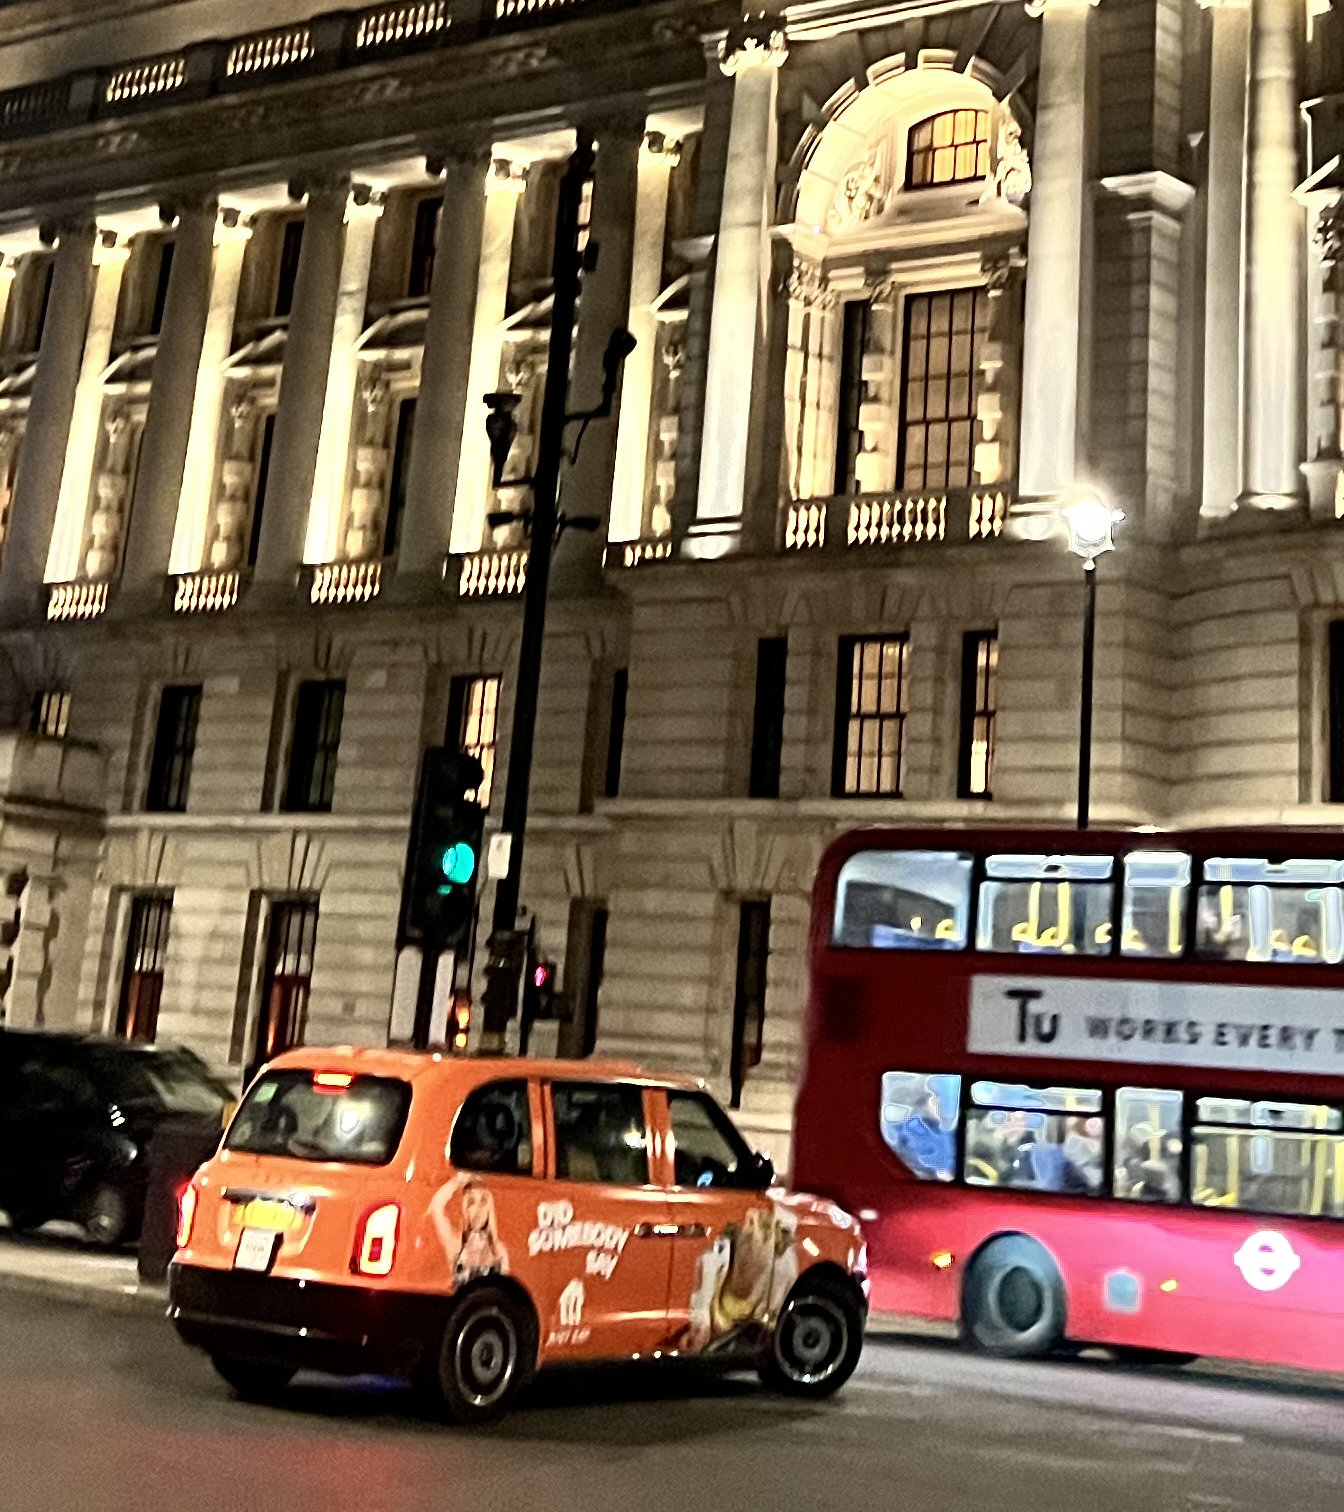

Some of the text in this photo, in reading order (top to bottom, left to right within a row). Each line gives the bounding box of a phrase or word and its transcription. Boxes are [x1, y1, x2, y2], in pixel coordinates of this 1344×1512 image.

[1005, 989, 1060, 1044] Tu
[1085, 1014, 1202, 1045] WORKS
[1214, 1022, 1320, 1053] EVERY
